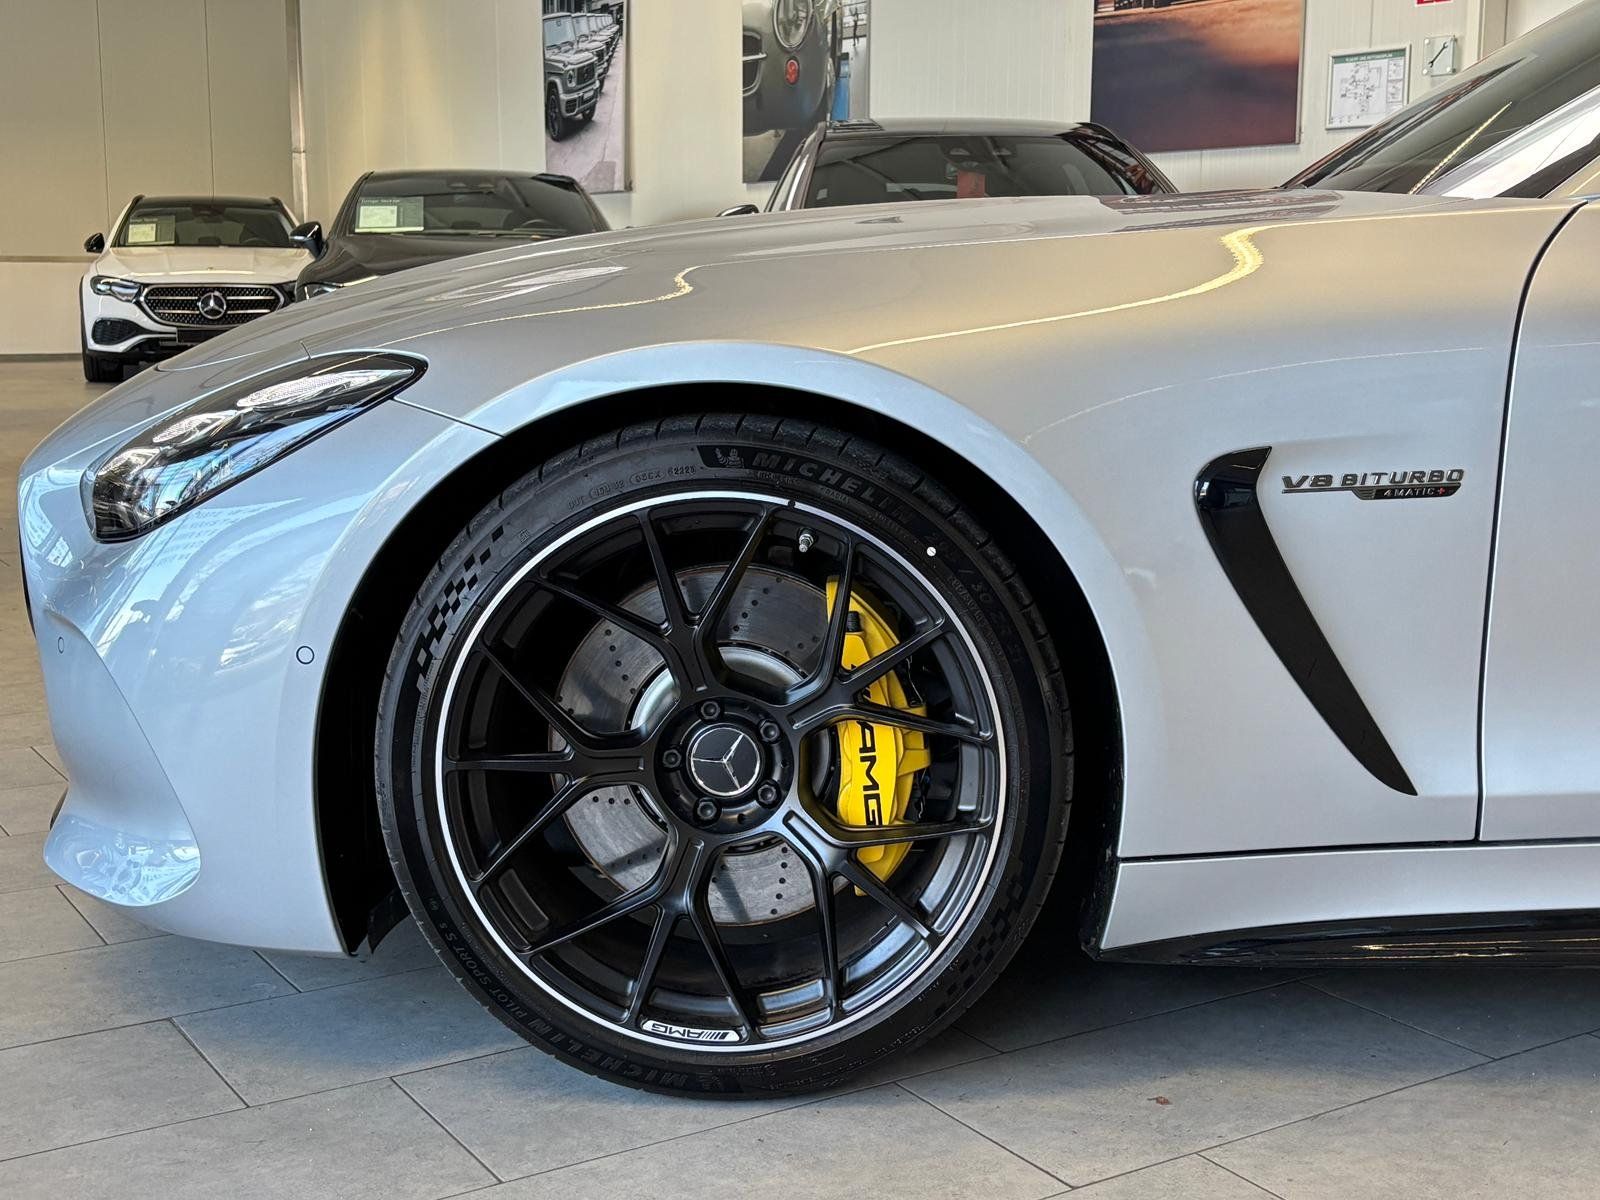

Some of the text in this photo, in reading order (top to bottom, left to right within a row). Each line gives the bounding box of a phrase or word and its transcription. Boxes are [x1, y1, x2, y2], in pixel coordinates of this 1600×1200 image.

[752, 452, 916, 525] MICHELIN
[1282, 469, 1465, 489] V8 BITURBO
[856, 720, 883, 826] AMG
[454, 946, 492, 986] SPORT
[489, 988, 528, 1020] PILOT
[651, 1022, 704, 1040] AMG
[528, 1018, 688, 1087] MICHELIN
